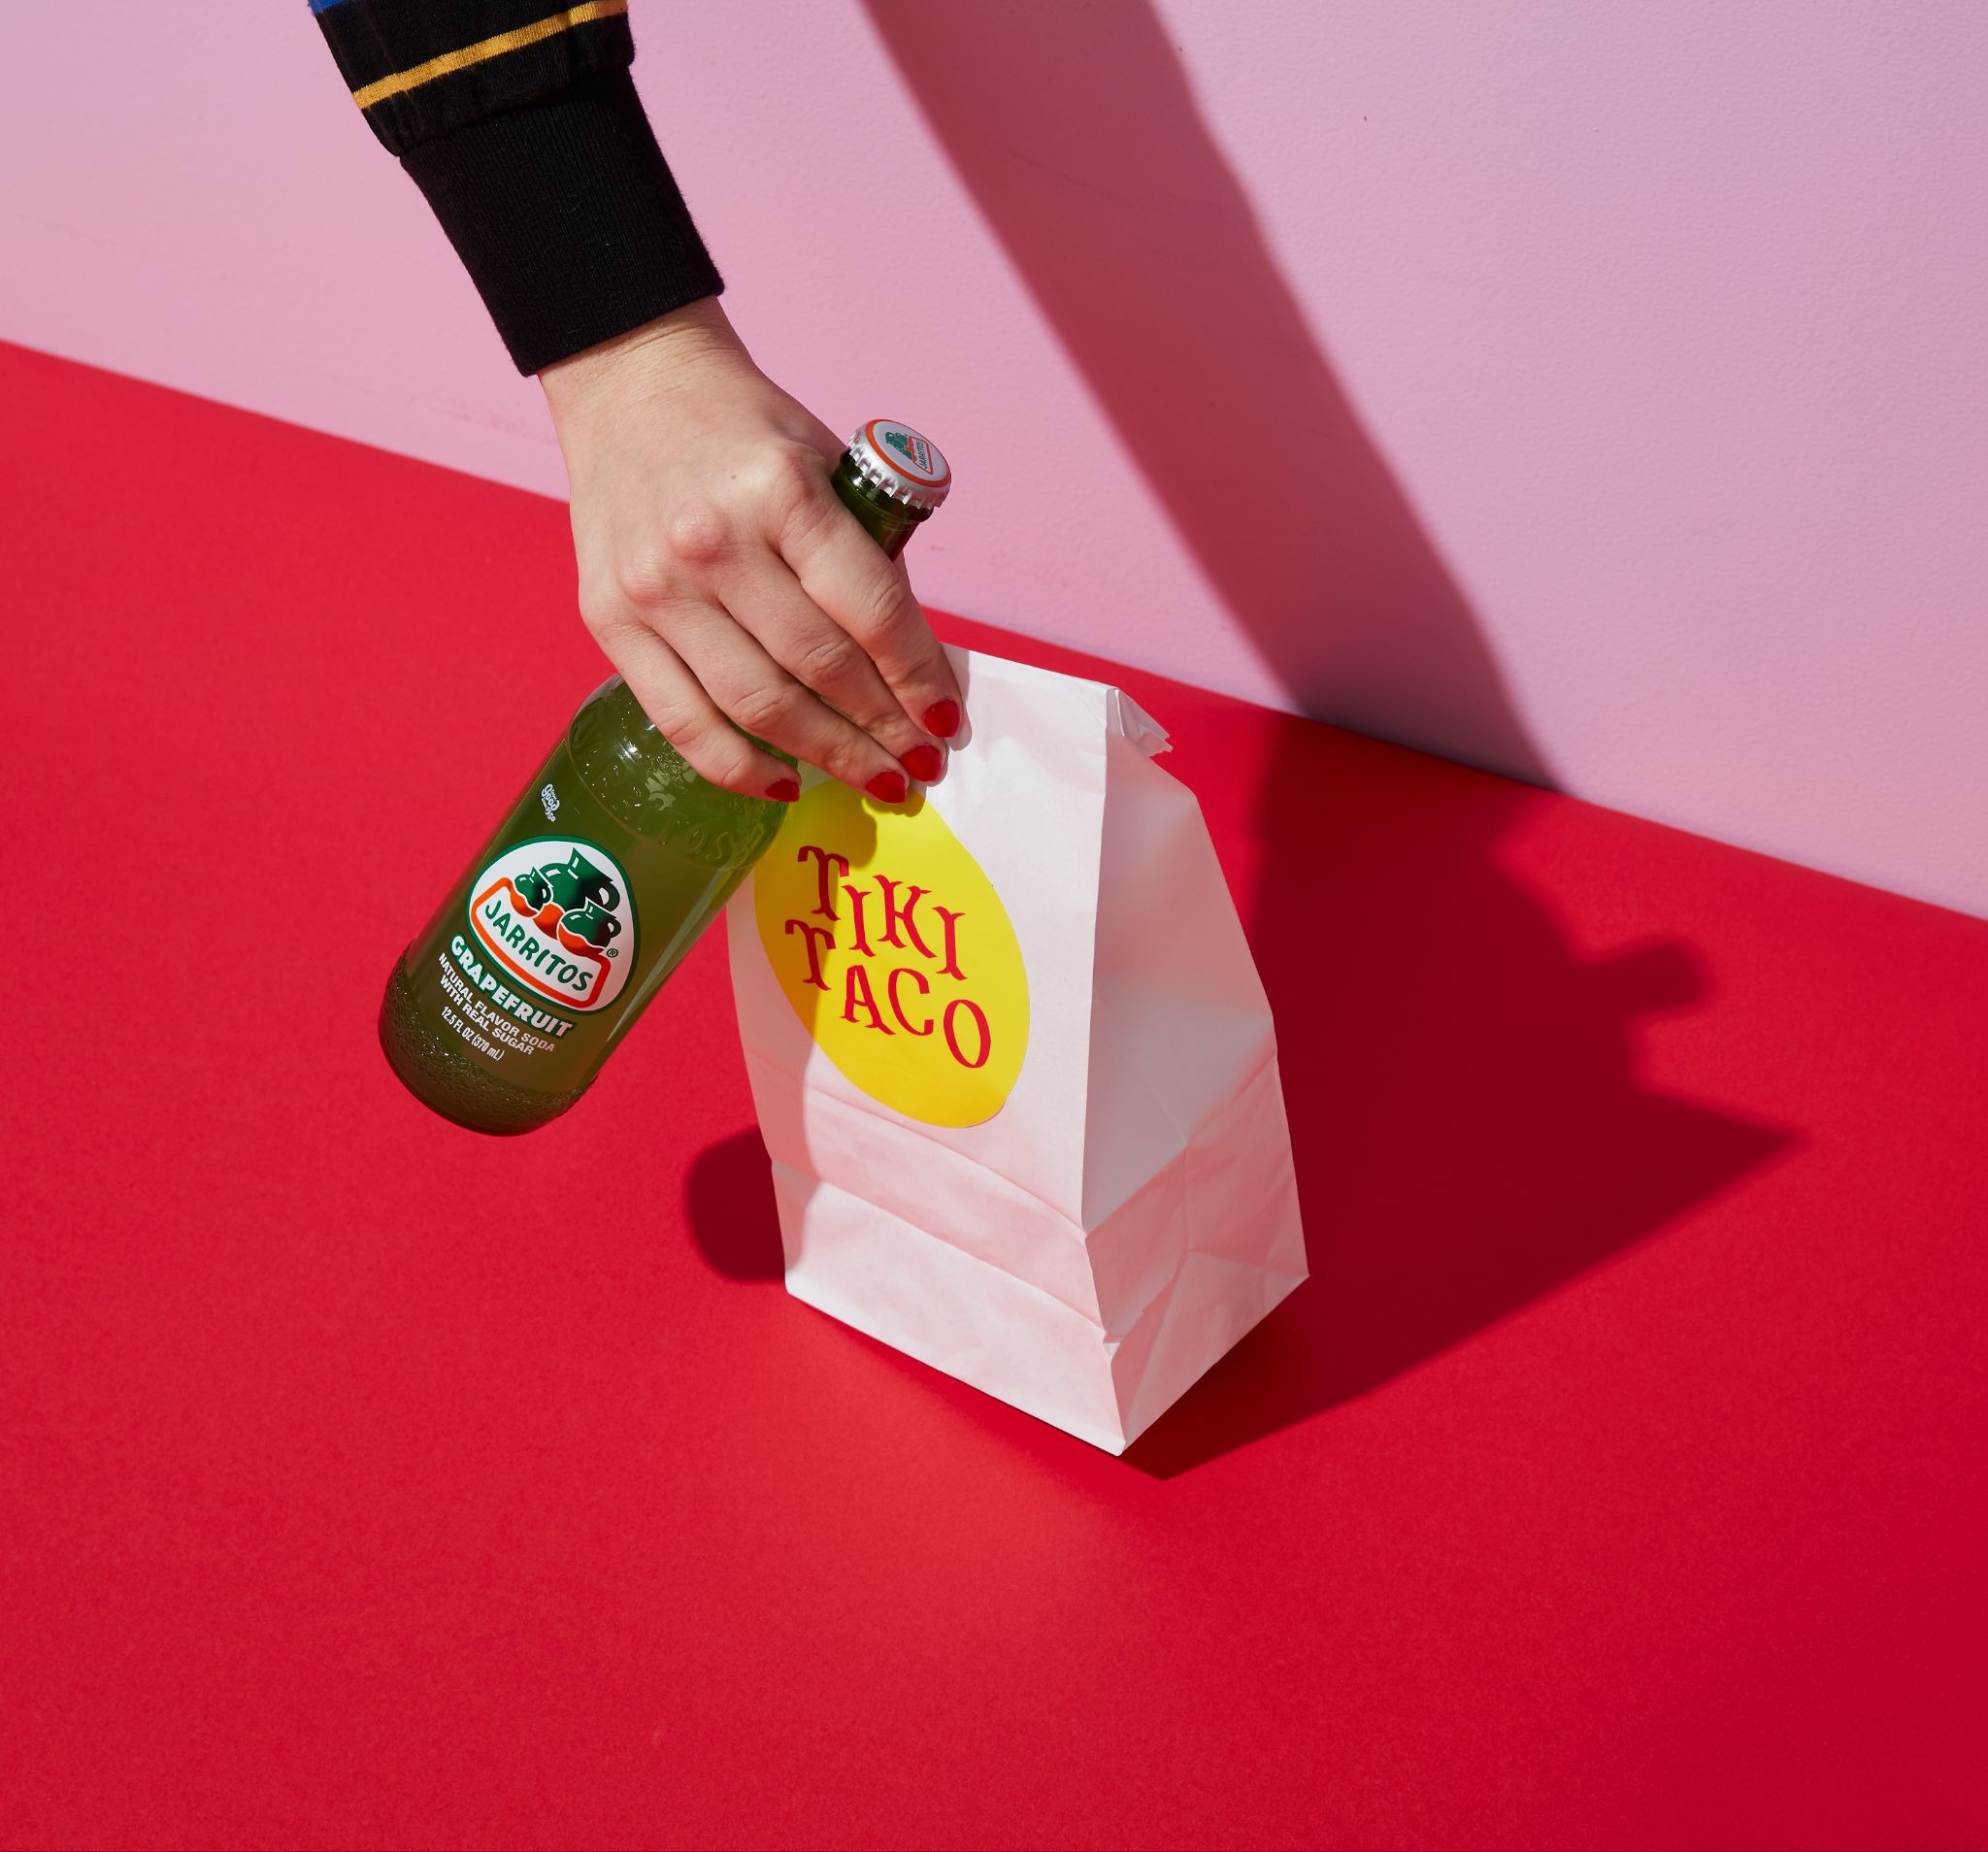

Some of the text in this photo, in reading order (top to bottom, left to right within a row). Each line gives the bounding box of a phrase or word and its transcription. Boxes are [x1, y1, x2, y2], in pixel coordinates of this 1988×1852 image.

[485, 900, 594, 991] JARRITOS
[797, 845, 969, 981] TIKI
[438, 952, 555, 1052] NATURAL FLAVOR SODA
[440, 975, 535, 1055] WITH REAL SUGAR
[441, 1007, 505, 1062] 12.5 FL OZ (370 mL)
[450, 935, 573, 1038] GRAPEFRUIT
[784, 918, 992, 1069] TACO
